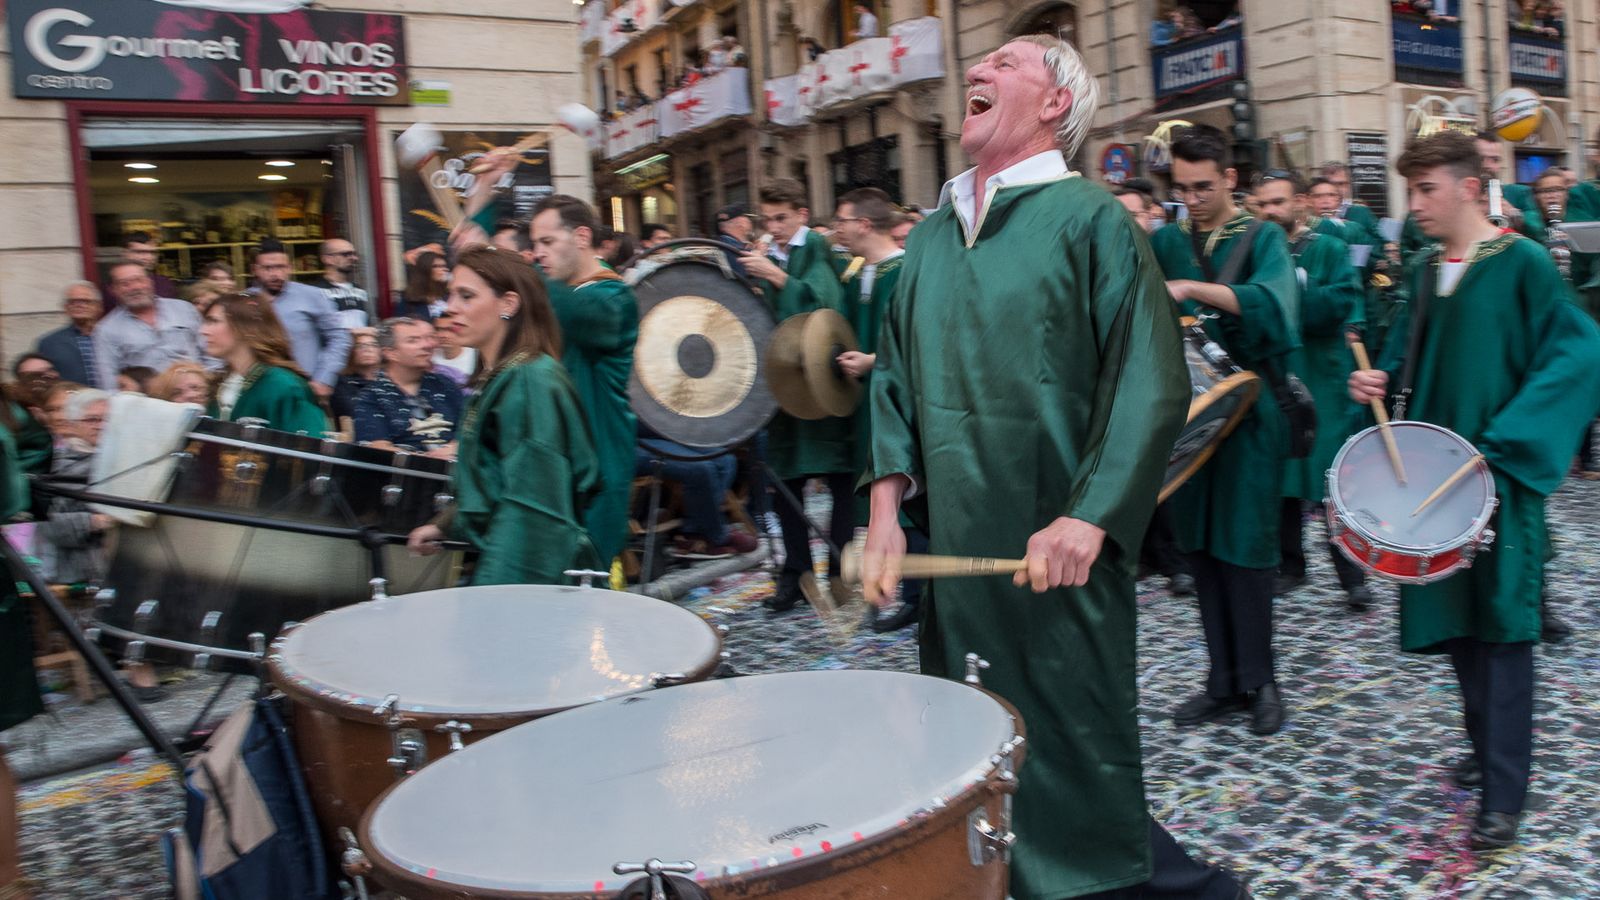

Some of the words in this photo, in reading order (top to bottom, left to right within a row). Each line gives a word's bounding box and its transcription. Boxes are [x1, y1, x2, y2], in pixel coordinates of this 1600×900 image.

[24, 7, 240, 72] Gourmet
[278, 40, 395, 67] VINOS
[239, 68, 399, 96] LICORES
